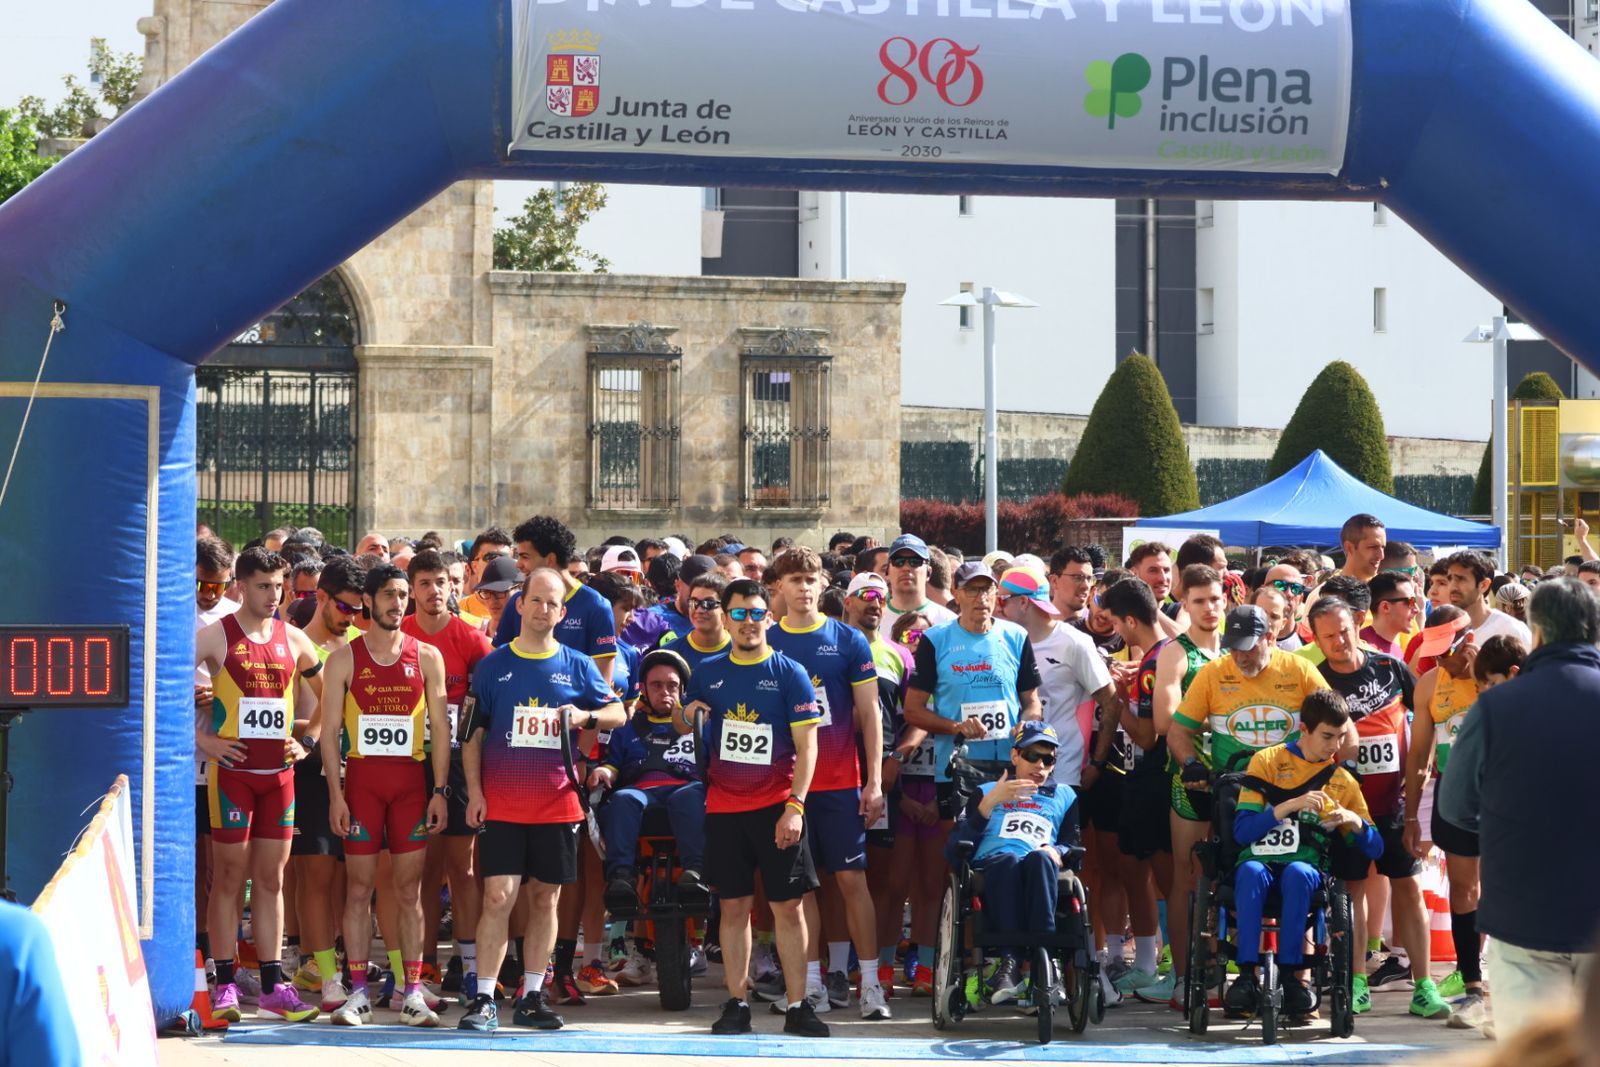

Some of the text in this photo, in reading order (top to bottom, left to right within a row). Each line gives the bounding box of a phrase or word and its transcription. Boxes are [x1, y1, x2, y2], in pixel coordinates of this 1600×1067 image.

[1162, 54, 1312, 105] Plena
[606, 96, 731, 119] Junta de
[848, 114, 1009, 127] Aniversario Unión de los Reinos de
[1160, 104, 1309, 135] inclusión
[527, 121, 731, 147] Castilla y León
[847, 123, 1008, 140] LEÓN Y CASTILLA
[901, 145, 942, 158] 2030
[1157, 138, 1327, 162] Castilla y León
[254, 673, 274, 681] VINO
[260, 681, 282, 690] TORO
[369, 704, 409, 713] DE TORO
[377, 696, 400, 704] VINO
[243, 709, 285, 729] 408
[516, 715, 561, 737] 1810
[1234, 719, 1288, 731] ALCER
[364, 727, 408, 746] 990
[725, 731, 769, 755] 592
[1358, 742, 1394, 765] 803
[1005, 819, 1046, 840] 565
